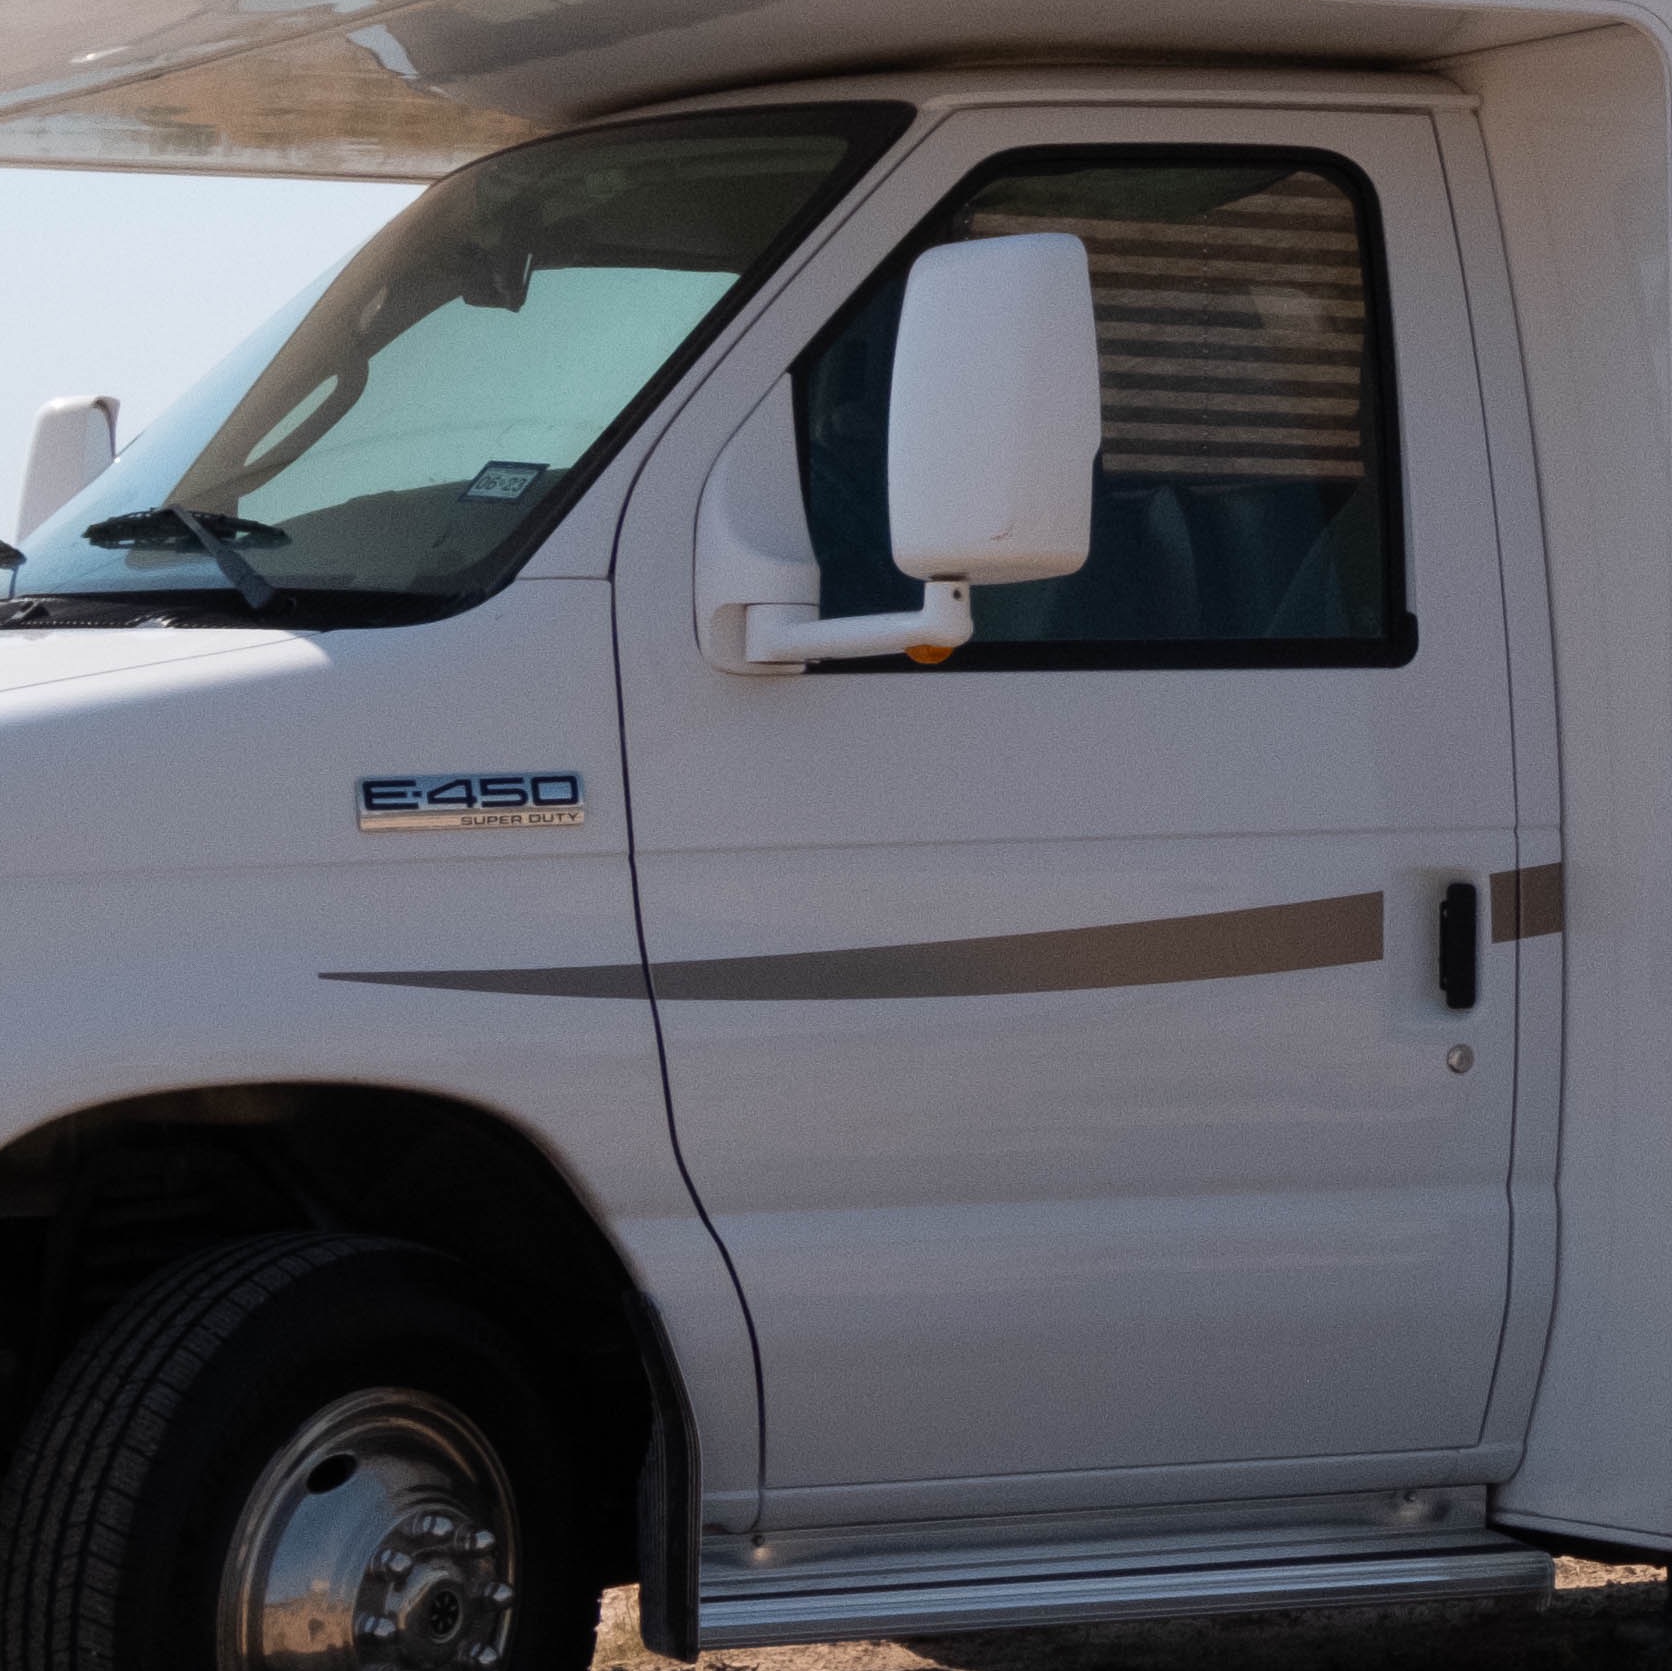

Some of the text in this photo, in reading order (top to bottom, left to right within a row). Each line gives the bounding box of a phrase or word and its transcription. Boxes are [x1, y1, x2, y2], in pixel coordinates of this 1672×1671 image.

[361, 775, 579, 811] E-450
[460, 812, 579, 826] SUPER DUTY
